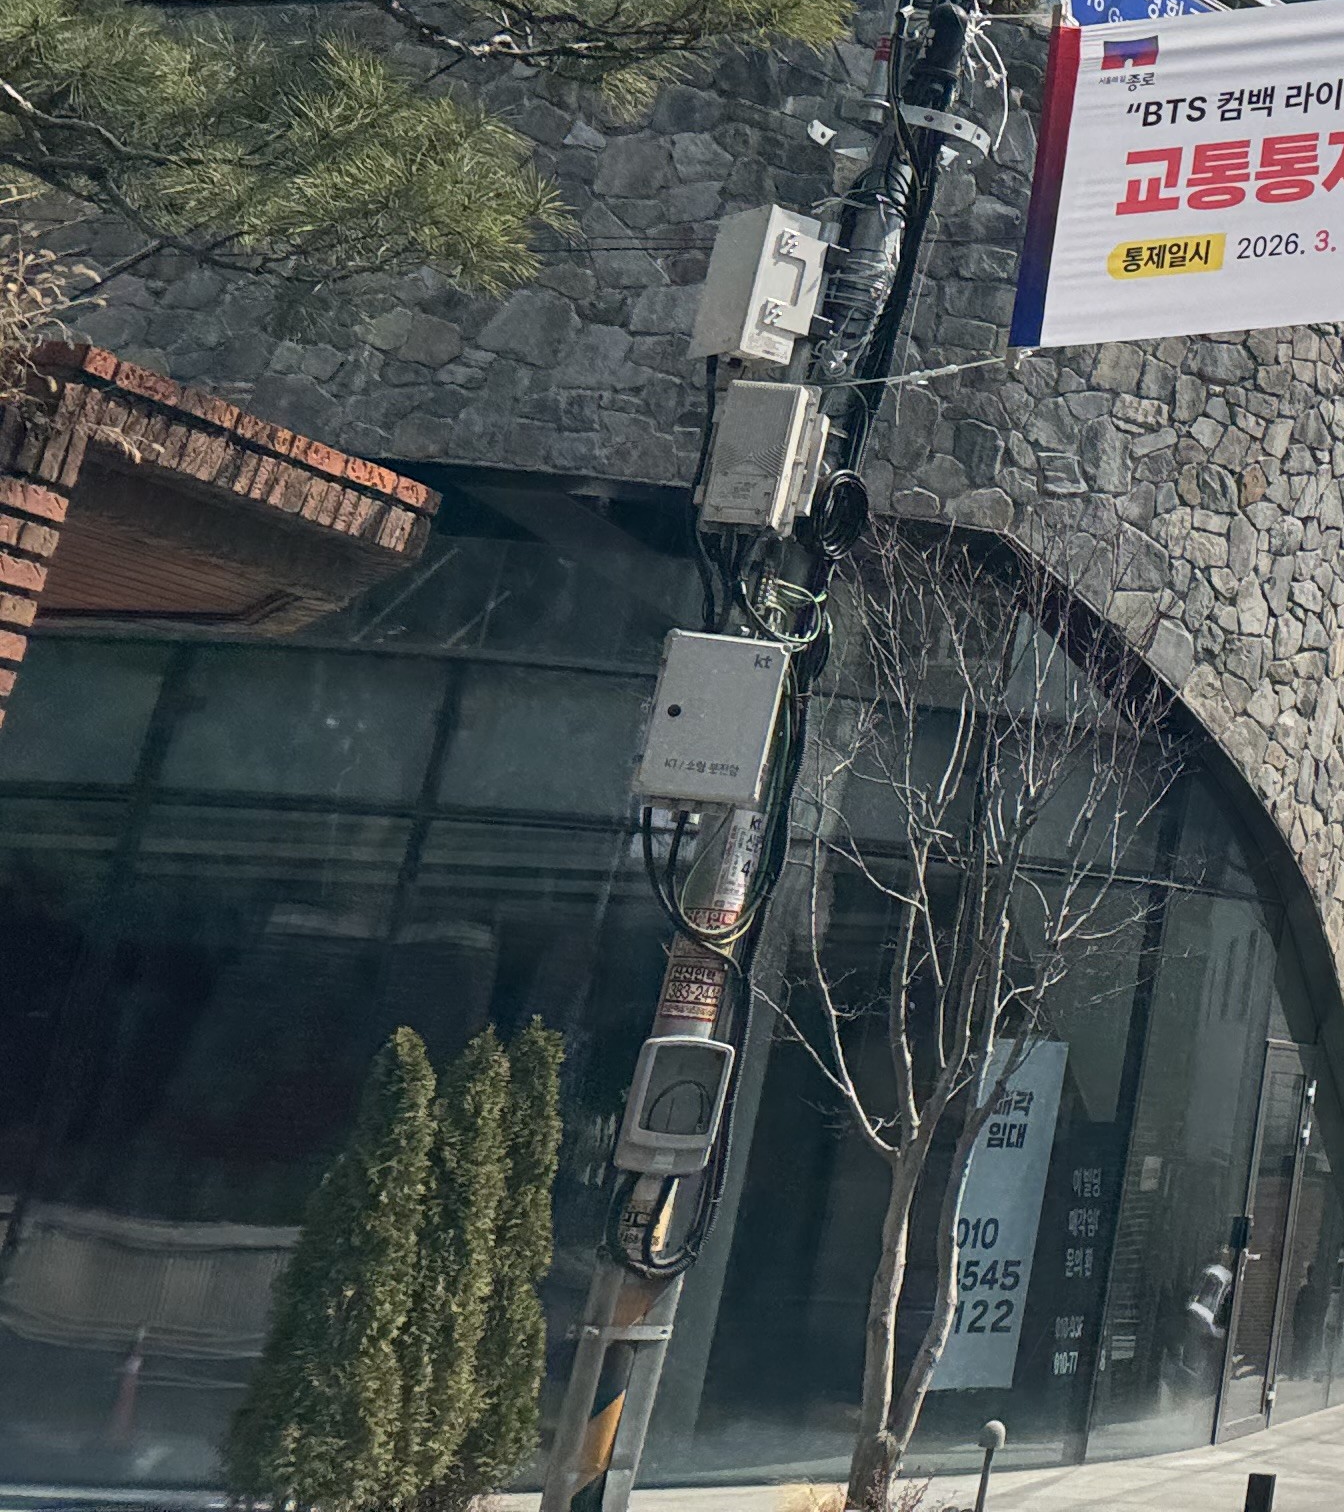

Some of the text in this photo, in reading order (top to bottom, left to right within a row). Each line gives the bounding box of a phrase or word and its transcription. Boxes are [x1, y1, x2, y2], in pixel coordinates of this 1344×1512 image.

[1126, 73, 1155, 91] 종로
[1217, 86, 1275, 121] 컴백
[1122, 239, 1211, 273] 통제일시
[1237, 233, 1305, 259] 2026.
[1315, 230, 1336, 252] 3.
[754, 653, 773, 669] kt
[986, 1122, 1028, 1149] 임대
[957, 1217, 999, 1249] 010
[956, 1259, 1021, 1291] 545
